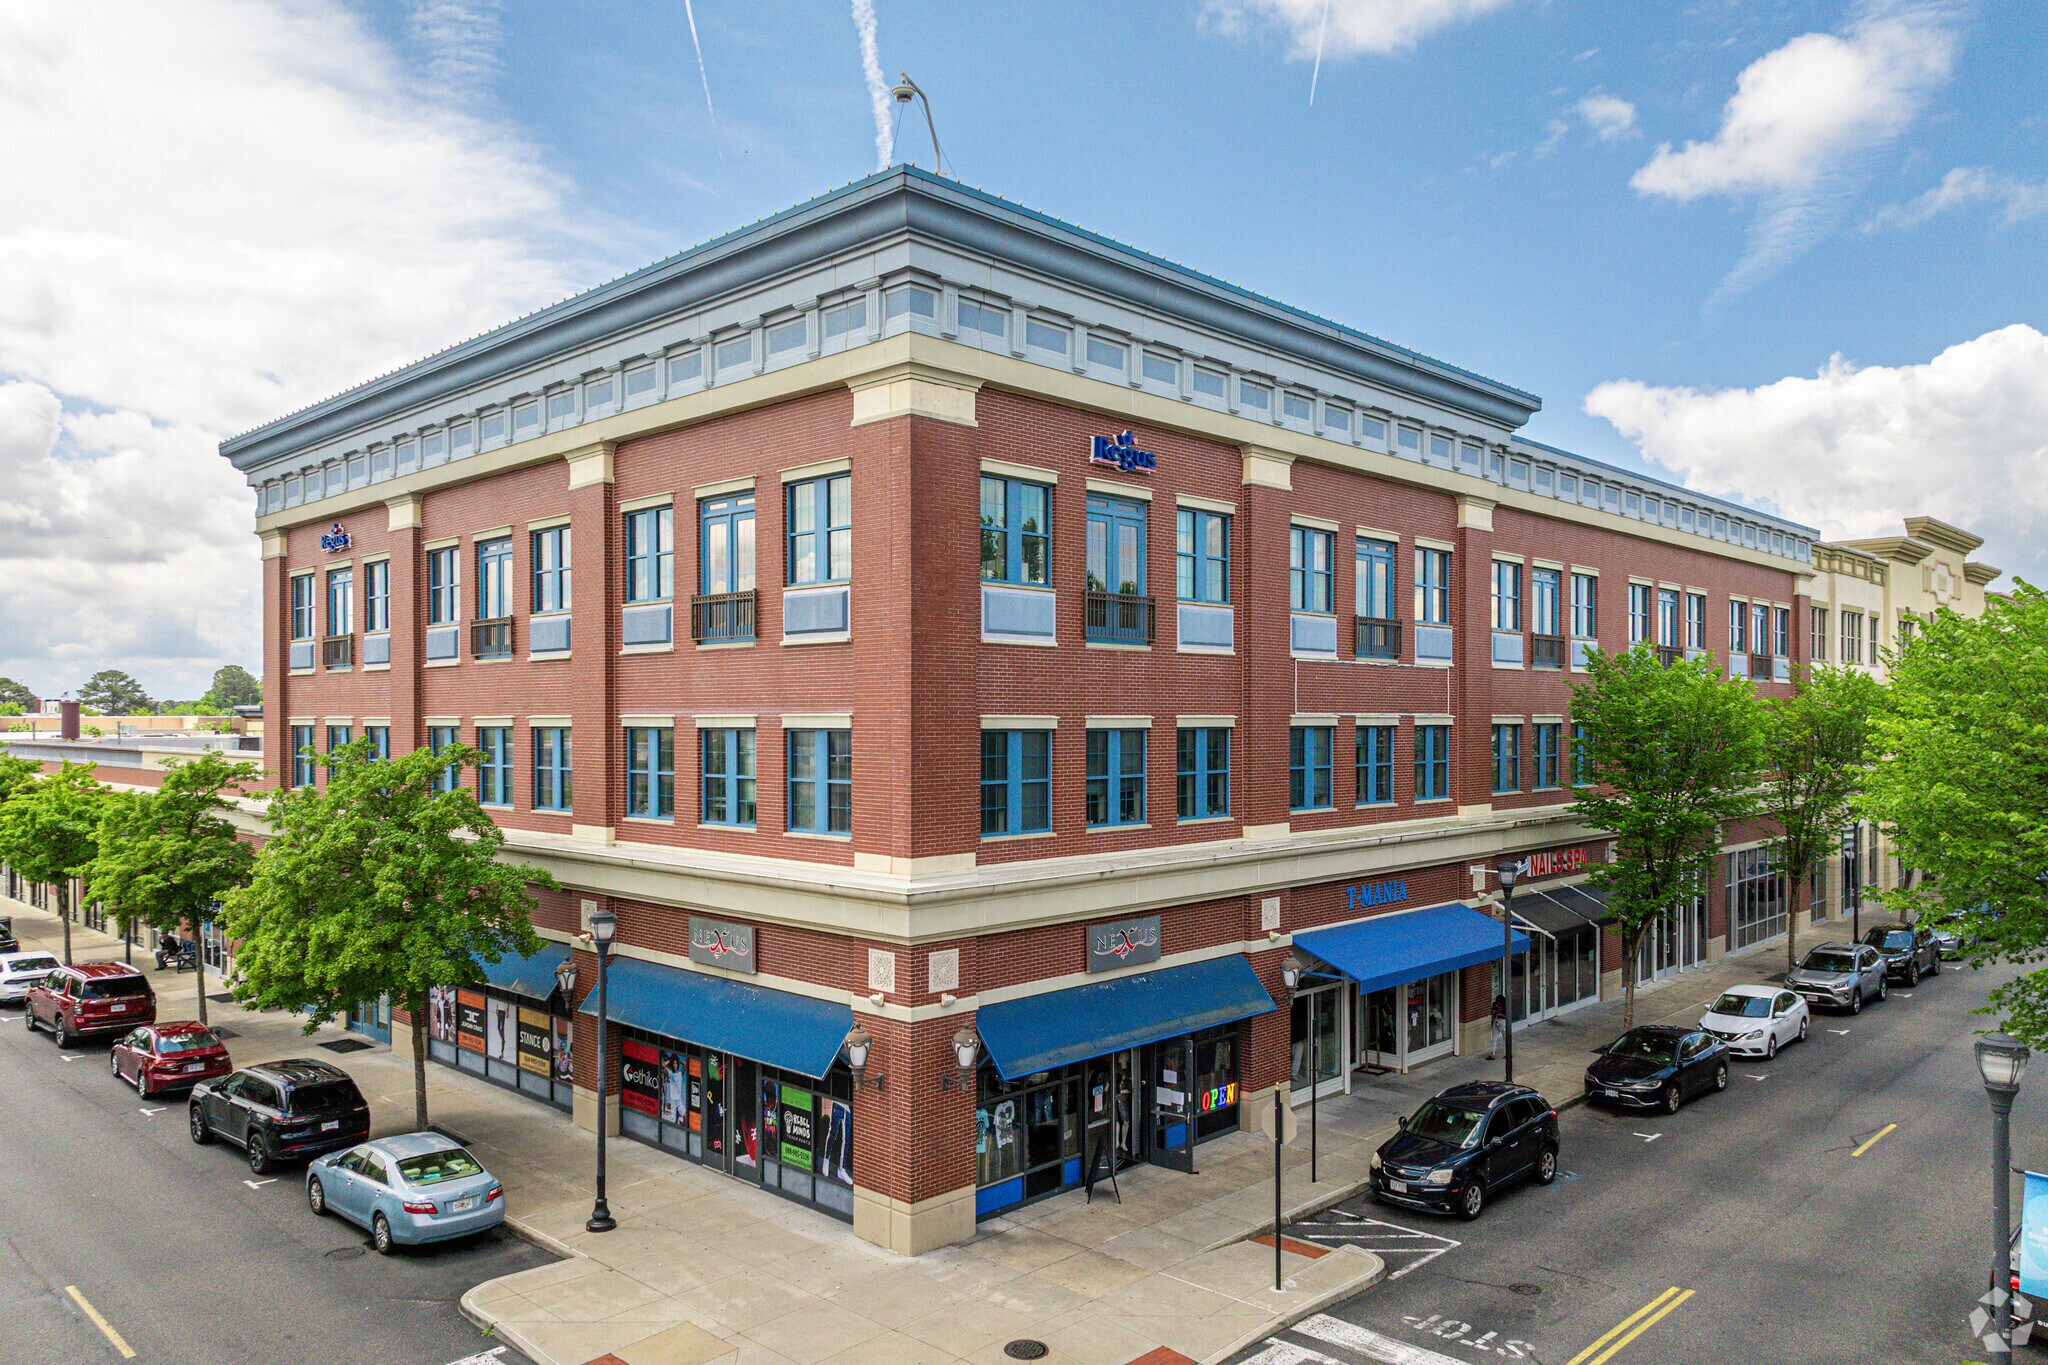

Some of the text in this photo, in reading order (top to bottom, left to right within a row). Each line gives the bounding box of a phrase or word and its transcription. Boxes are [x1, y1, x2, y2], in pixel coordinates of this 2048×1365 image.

[1089, 434, 1157, 472] Regus
[320, 533, 350, 552] Regus
[1527, 851, 1564, 877] NAILS
[1566, 848, 1588, 871] SPA
[1345, 879, 1409, 910] T-MANIA
[519, 1030, 542, 1049] STANCE
[1202, 1083, 1235, 1112] OPEN
[792, 1124, 811, 1139] MINDS
[793, 1114, 810, 1128] REBEL
